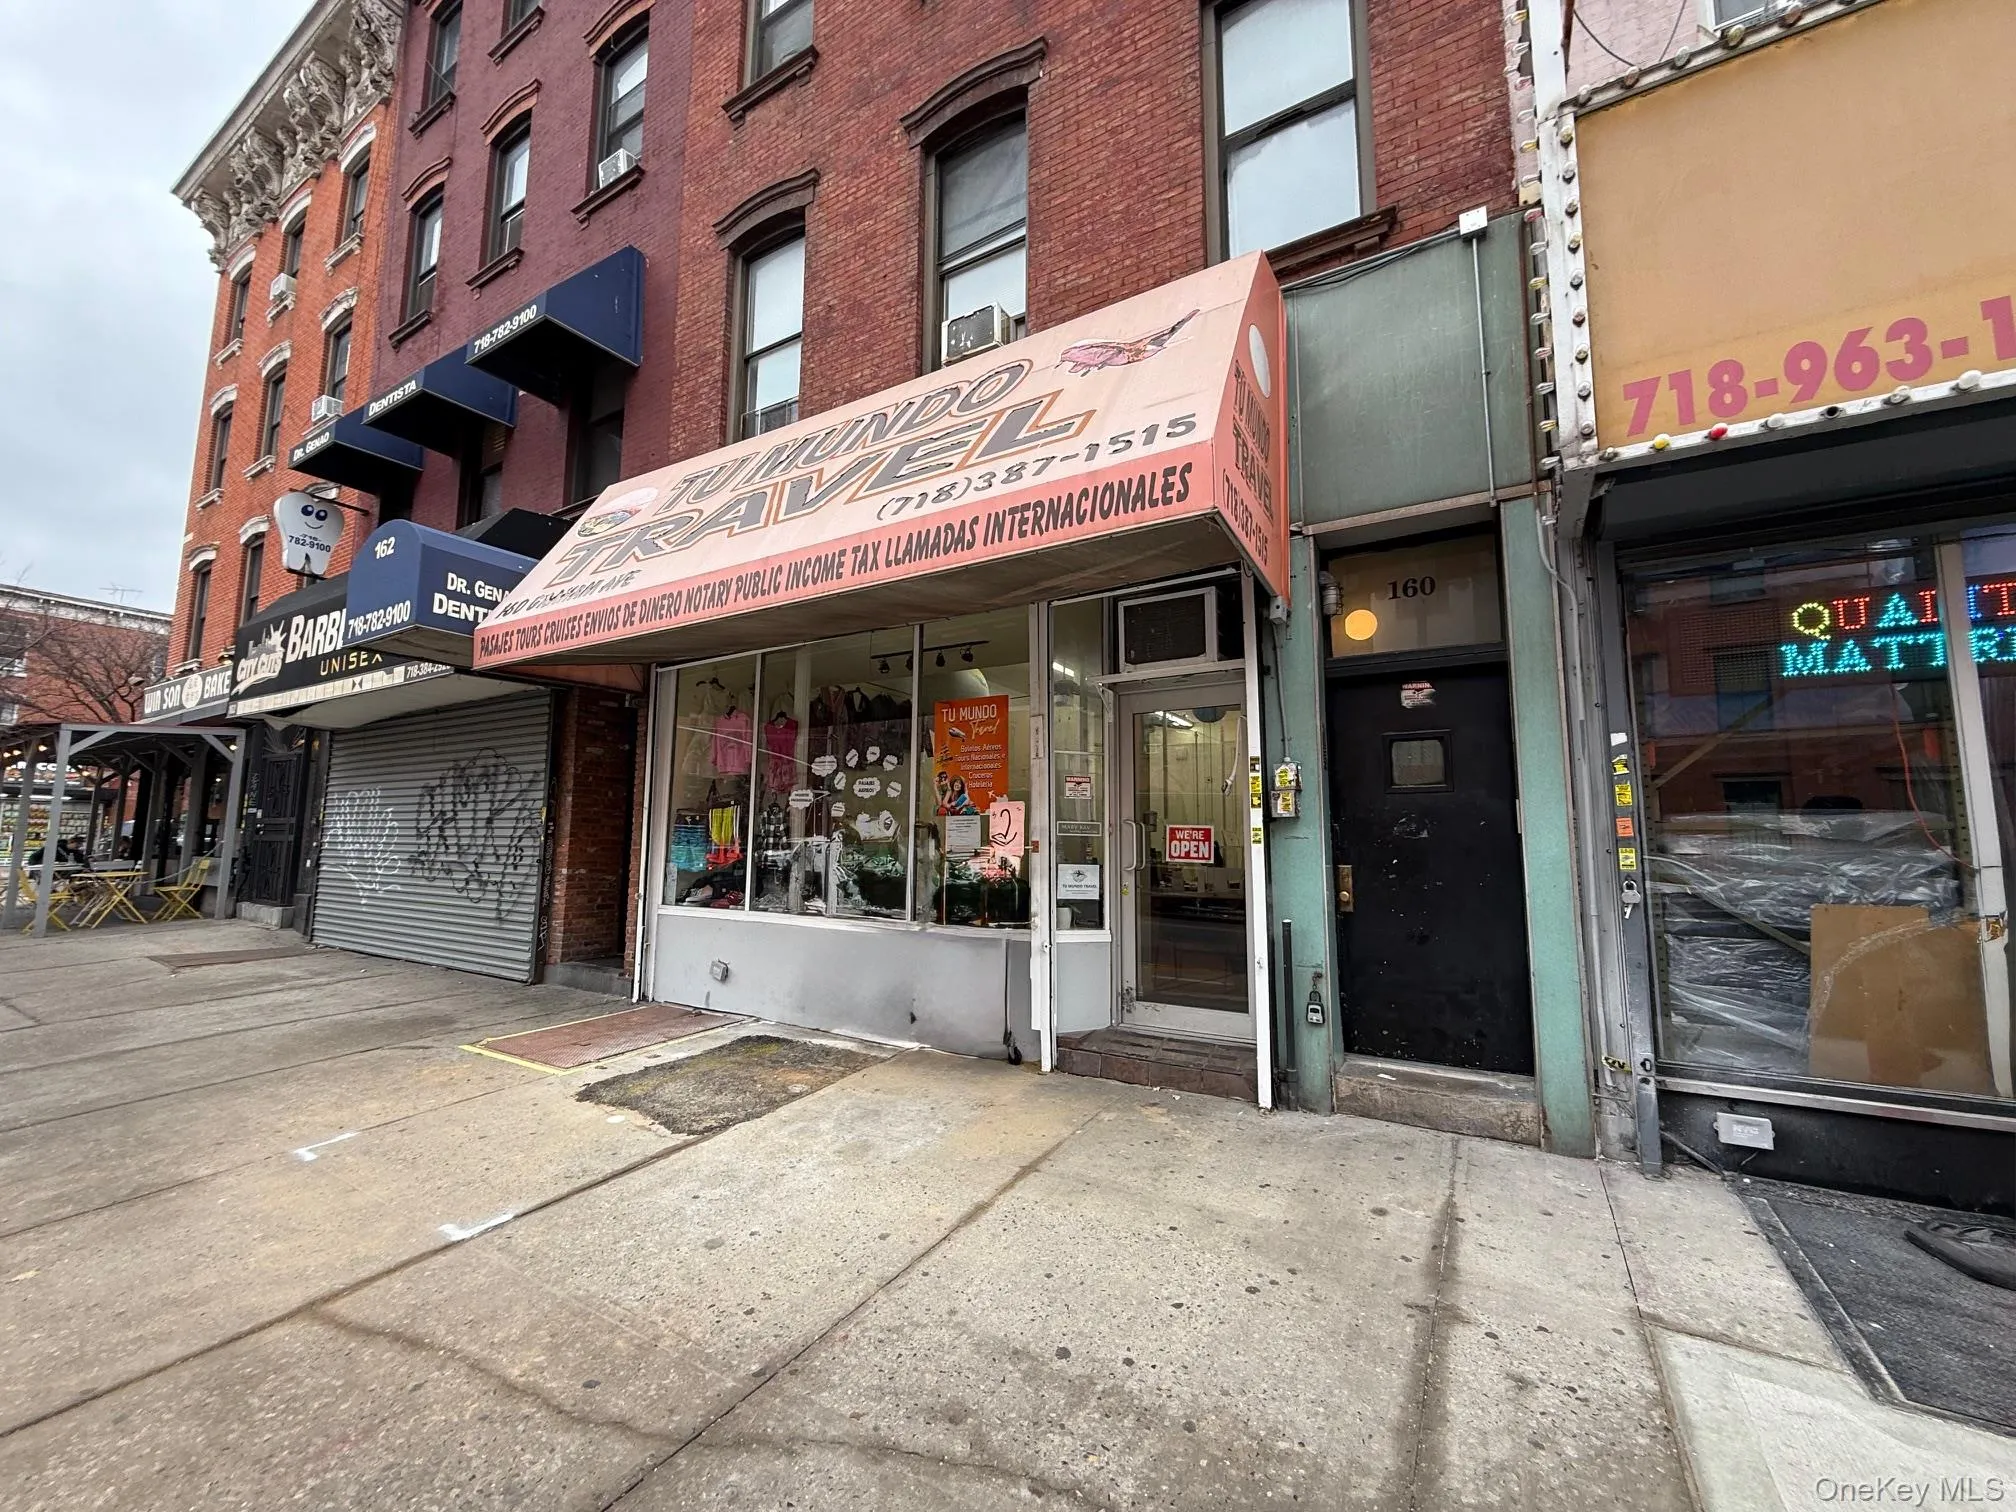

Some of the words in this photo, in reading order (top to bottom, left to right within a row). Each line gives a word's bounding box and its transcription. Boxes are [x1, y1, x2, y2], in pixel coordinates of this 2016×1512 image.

[473, 304, 537, 353] 718-782-9100
[1623, 295, 2016, 438] 718-963-1
[369, 380, 417, 416] DENTISTA
[305, 431, 330, 453] GENAO
[653, 451, 759, 516] TU
[734, 358, 1033, 491] MUNDO
[876, 412, 1197, 521] (718)387-1515
[546, 389, 1097, 590] TRAVEL
[288, 534, 331, 552] 782-9100
[375, 537, 394, 559] 162
[479, 628, 514, 660] PASAJES
[515, 623, 543, 650] TOURS
[543, 613, 581, 645] CRUISES
[583, 604, 622, 637] ENVIOS
[622, 600, 638, 629] DE
[638, 590, 683, 625] DINERO
[683, 577, 734, 615] NOTARY
[734, 564, 783, 603] PUBLIC
[784, 549, 847, 592] INCOME
[851, 541, 880, 576] TAX
[884, 515, 979, 567] LLAMADAS
[983, 462, 1192, 547] INTERNACIONALES
[447, 572, 471, 595] DR.
[1388, 576, 1436, 600] 160
[347, 600, 410, 639] 718-782-9100
[432, 592, 493, 623] DENT
[236, 657, 259, 682] CITY
[258, 653, 283, 675] CUTS
[942, 707, 956, 722] TU
[960, 703, 997, 721] MUNDO
[1170, 840, 1210, 858] OPEN
[1175, 829, 1205, 840] WE'RE
